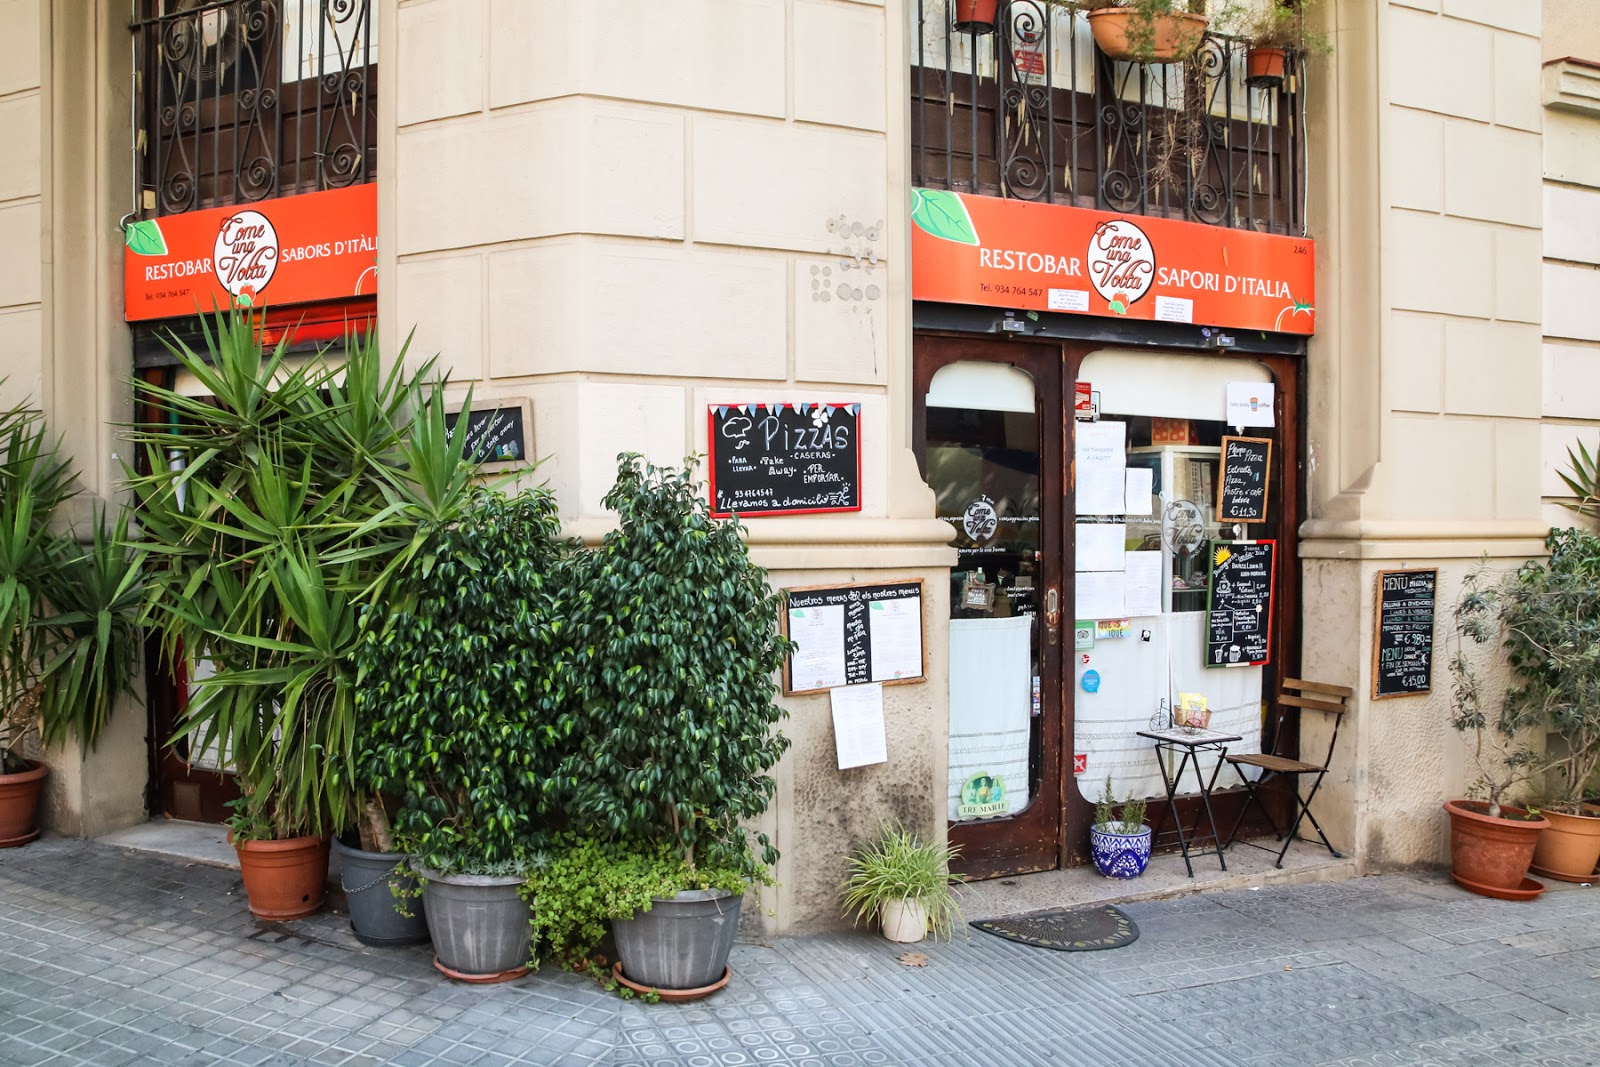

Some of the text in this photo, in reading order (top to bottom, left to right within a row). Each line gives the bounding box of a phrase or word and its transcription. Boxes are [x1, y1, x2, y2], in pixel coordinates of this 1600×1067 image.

[220, 217, 265, 246] Come
[1094, 222, 1142, 252] Come
[231, 239, 256, 255] una
[282, 235, 378, 263] SABORS D'ITÀLI
[1293, 244, 1307, 256] 246
[979, 246, 1081, 277] RESTOBAR
[1106, 248, 1131, 263] una
[145, 257, 212, 281] RESTOBAR
[219, 246, 277, 284] Volta
[1092, 258, 1152, 291] Volta
[1157, 265, 1292, 300] SAPORI D'ITALIA
[155, 291, 166, 300] 934
[167, 290, 178, 299] 764
[178, 288, 189, 297] 547
[979, 283, 1044, 297] Tel. 934 764 547
[1383, 577, 1408, 591] MENU
[789, 596, 824, 608] Nuestros
[1382, 647, 1404, 662] MENU
[962, 803, 1005, 814] TRE MARIE
